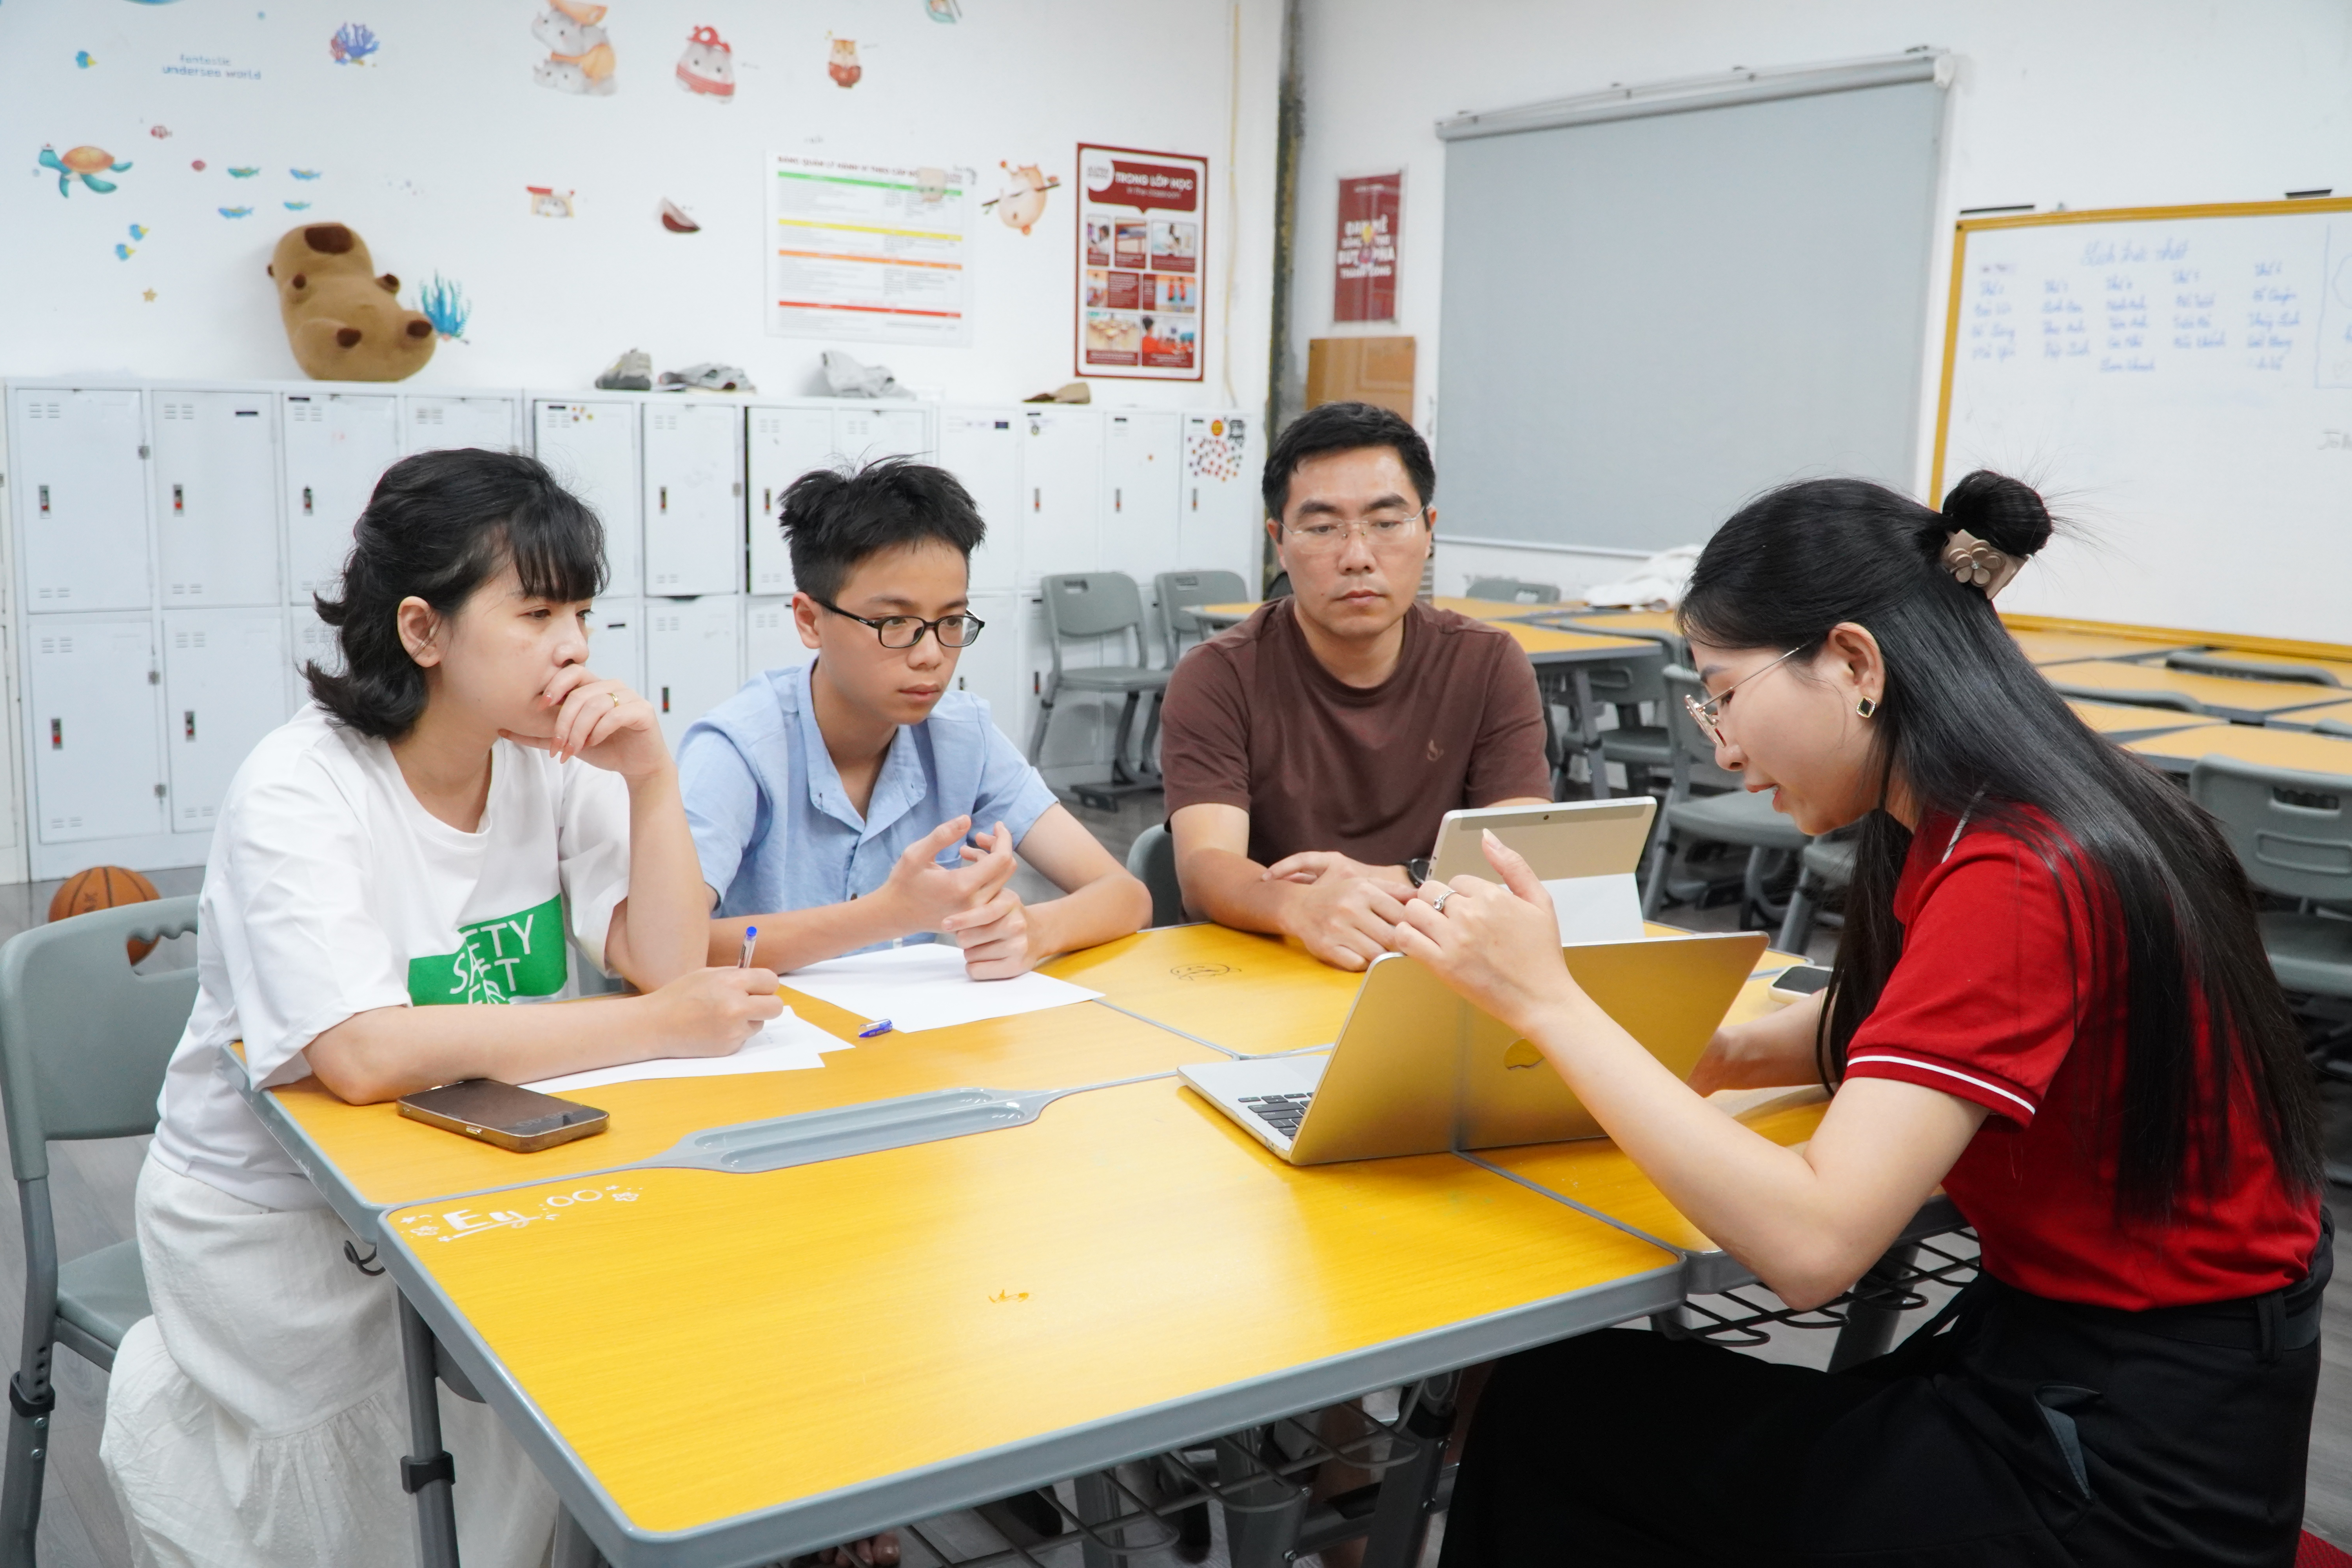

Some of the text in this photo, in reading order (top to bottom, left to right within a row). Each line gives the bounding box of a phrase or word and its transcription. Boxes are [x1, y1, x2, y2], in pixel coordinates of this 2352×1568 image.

[163, 65, 261, 80] undersea world
[1115, 171, 1149, 186] TRONG
[1149, 173, 1170, 187] LỚP
[1170, 178, 1194, 192] HỌC
